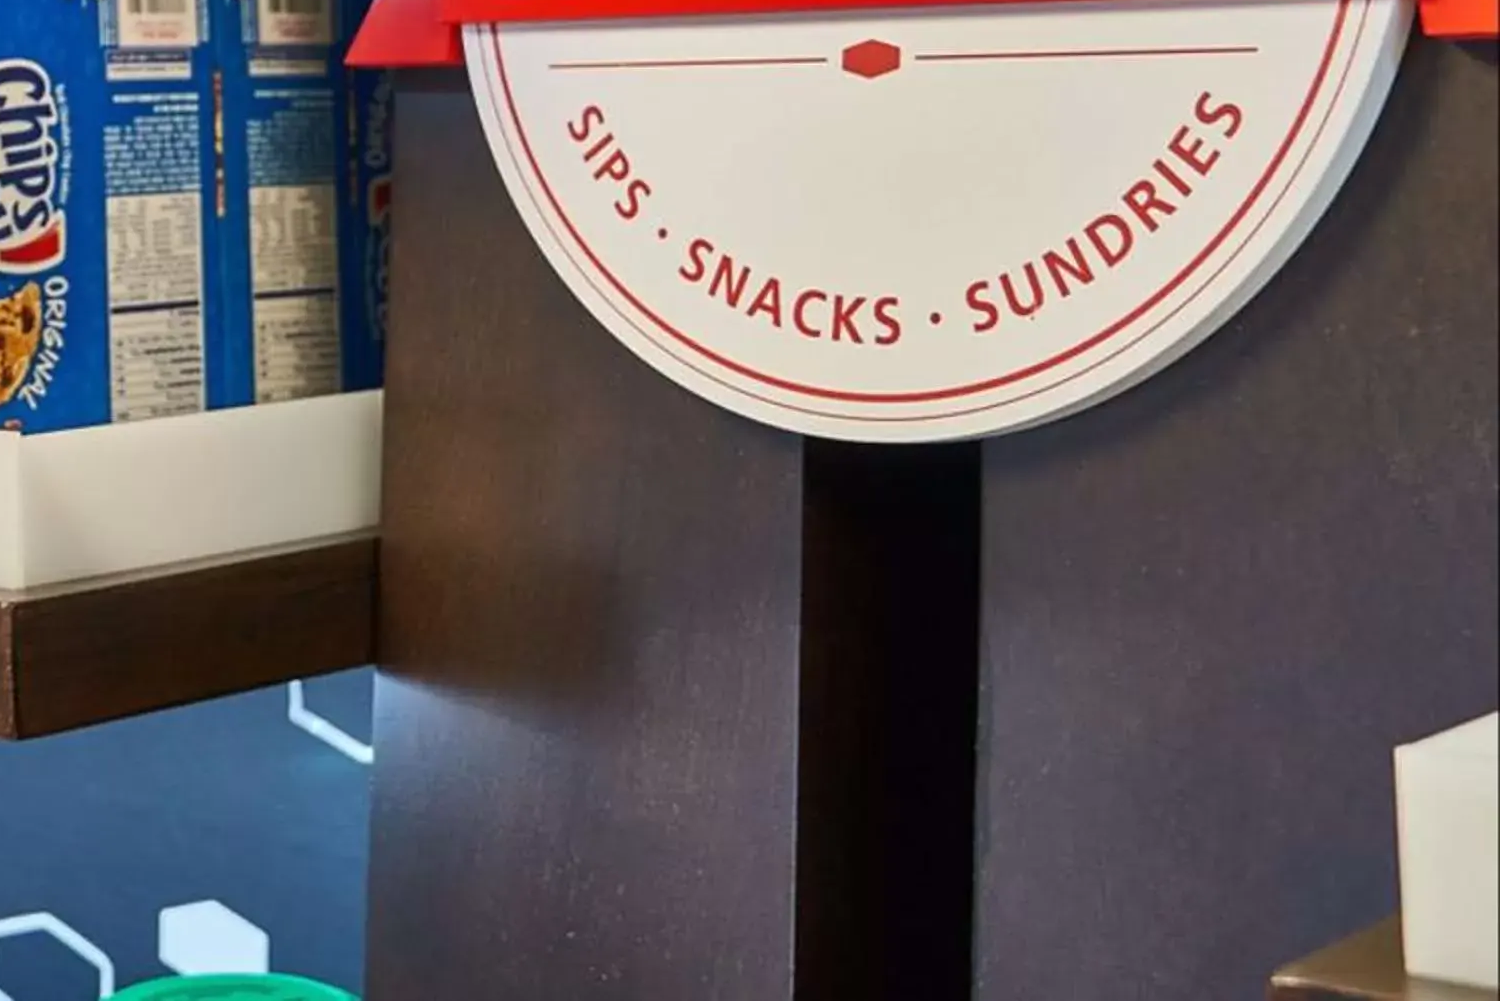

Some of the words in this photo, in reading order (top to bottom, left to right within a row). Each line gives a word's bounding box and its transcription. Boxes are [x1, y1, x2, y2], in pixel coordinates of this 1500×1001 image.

[568, 105, 651, 220] SIPS
[680, 238, 902, 345] SNACKS
[966, 92, 1242, 332] SUNDRIES
[17, 276, 69, 409] ORIGINAL
